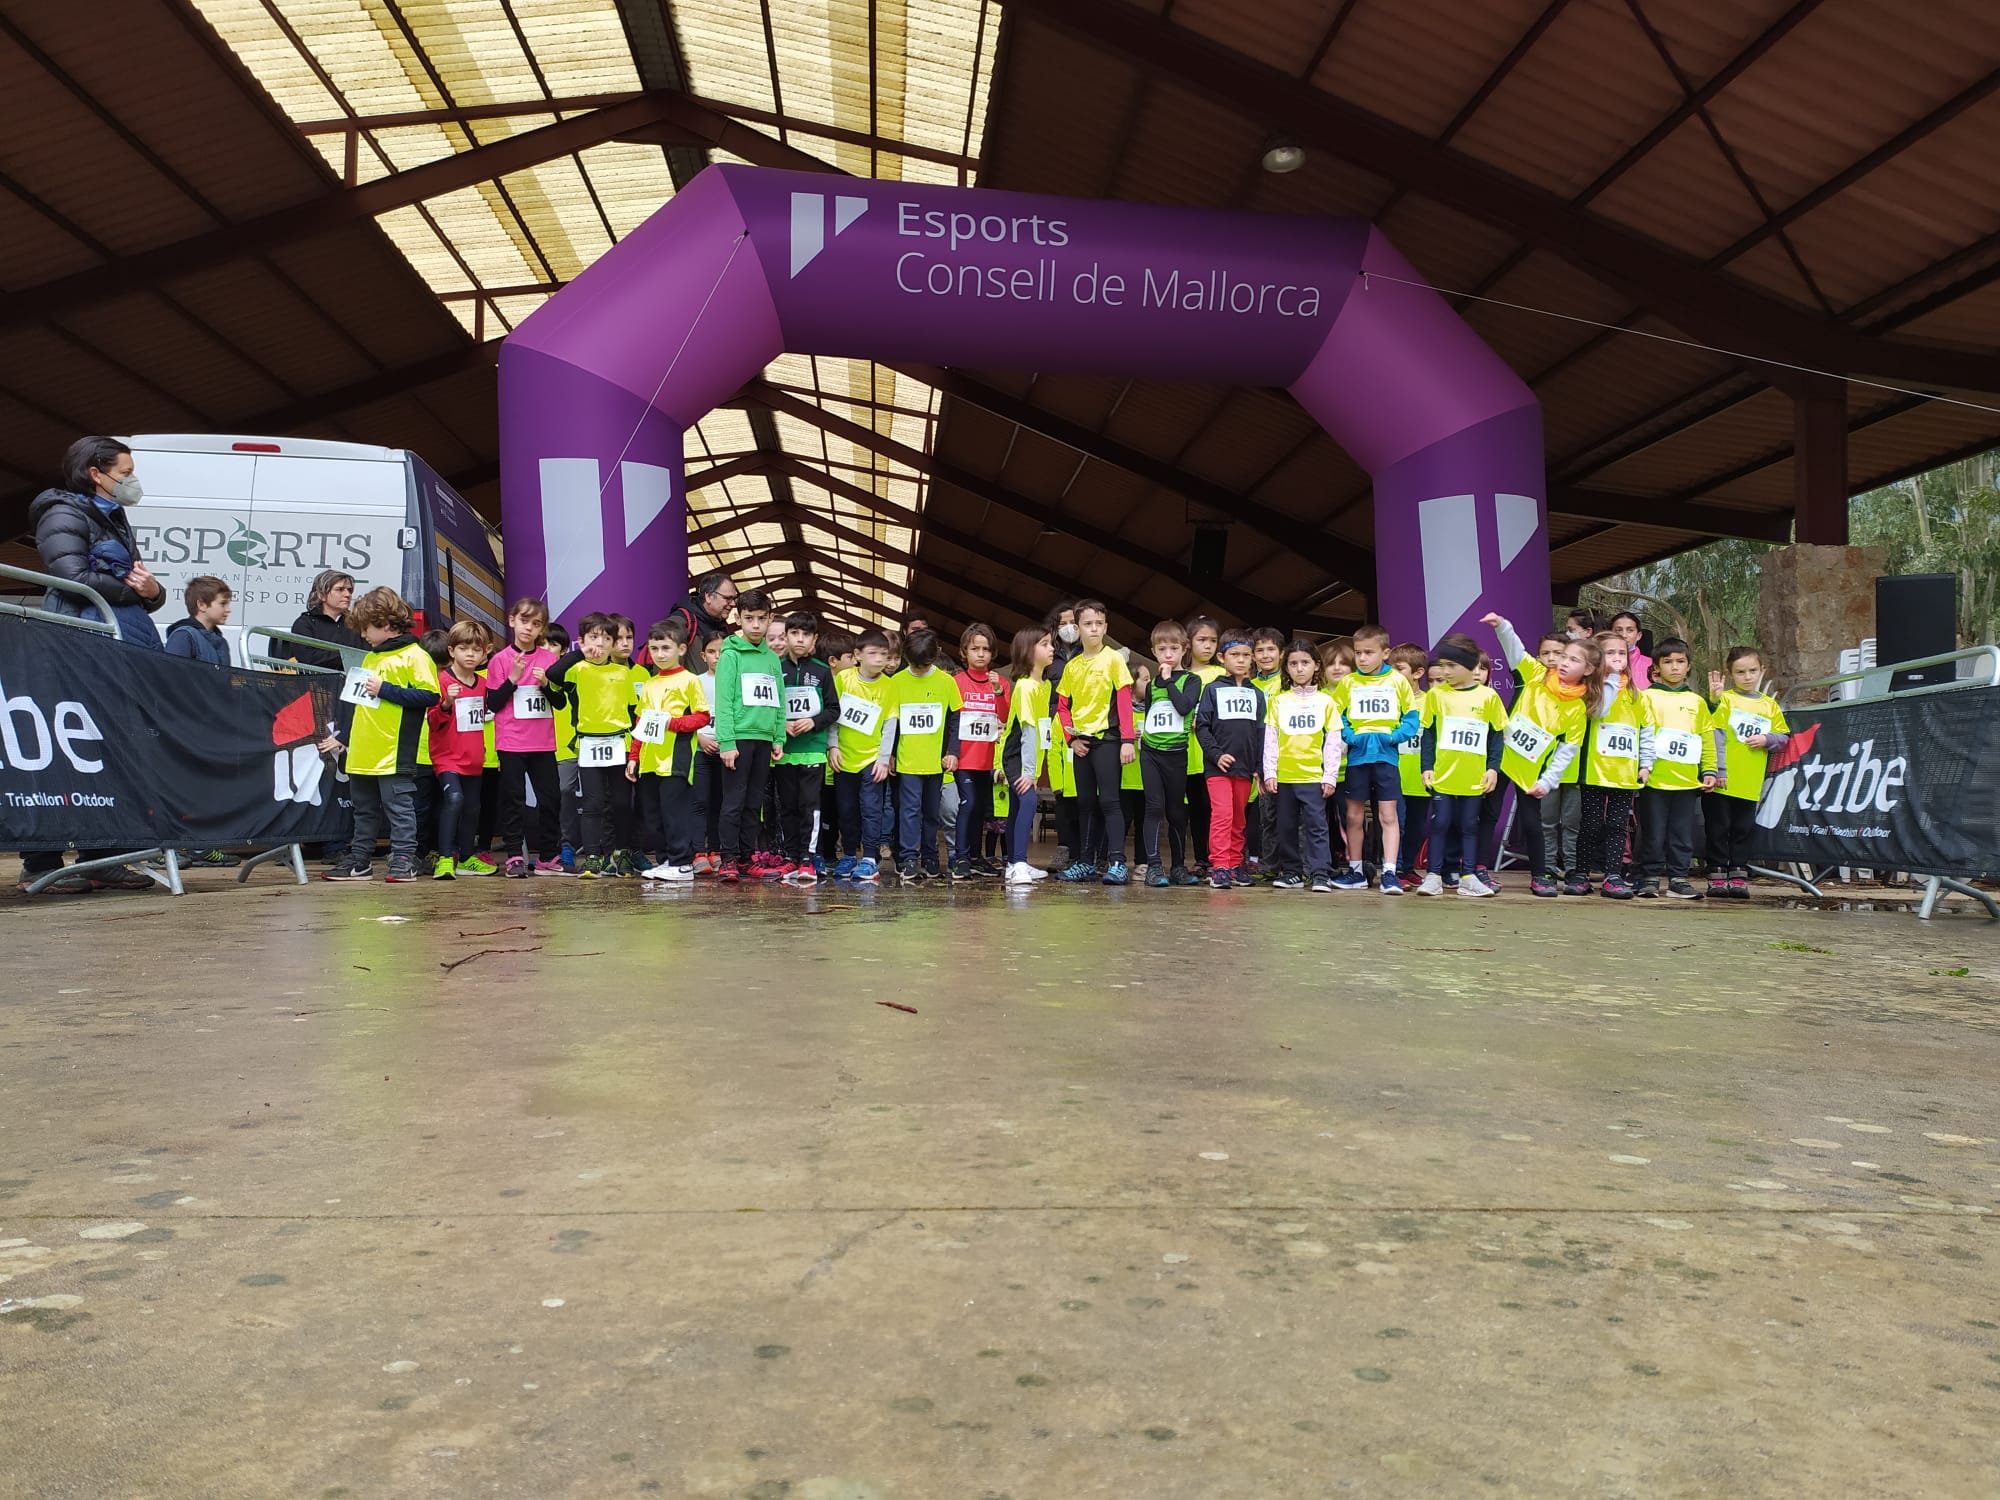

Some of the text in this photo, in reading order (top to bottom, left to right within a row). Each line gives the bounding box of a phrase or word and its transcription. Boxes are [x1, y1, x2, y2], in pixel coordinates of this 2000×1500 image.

[897, 202, 1069, 250] Esports
[896, 252, 1320, 317] Consell de Mallorca
[753, 685, 773, 700] 441
[526, 697, 546, 712] 148
[788, 698, 810, 713] 124
[1225, 698, 1253, 714] 1123
[1358, 698, 1390, 713] 1163
[844, 707, 869, 726] 467
[909, 714, 934, 729] 450
[1153, 712, 1173, 727] 151
[1288, 714, 1316, 729] 466
[643, 722, 659, 738] 451
[969, 722, 990, 736] 154
[1450, 729, 1481, 747] 1167
[1511, 729, 1537, 752] 493
[1607, 735, 1633, 753] 494
[590, 745, 613, 761] 119
[1668, 740, 1687, 757] 95
[1797, 738, 1907, 813] tribe
